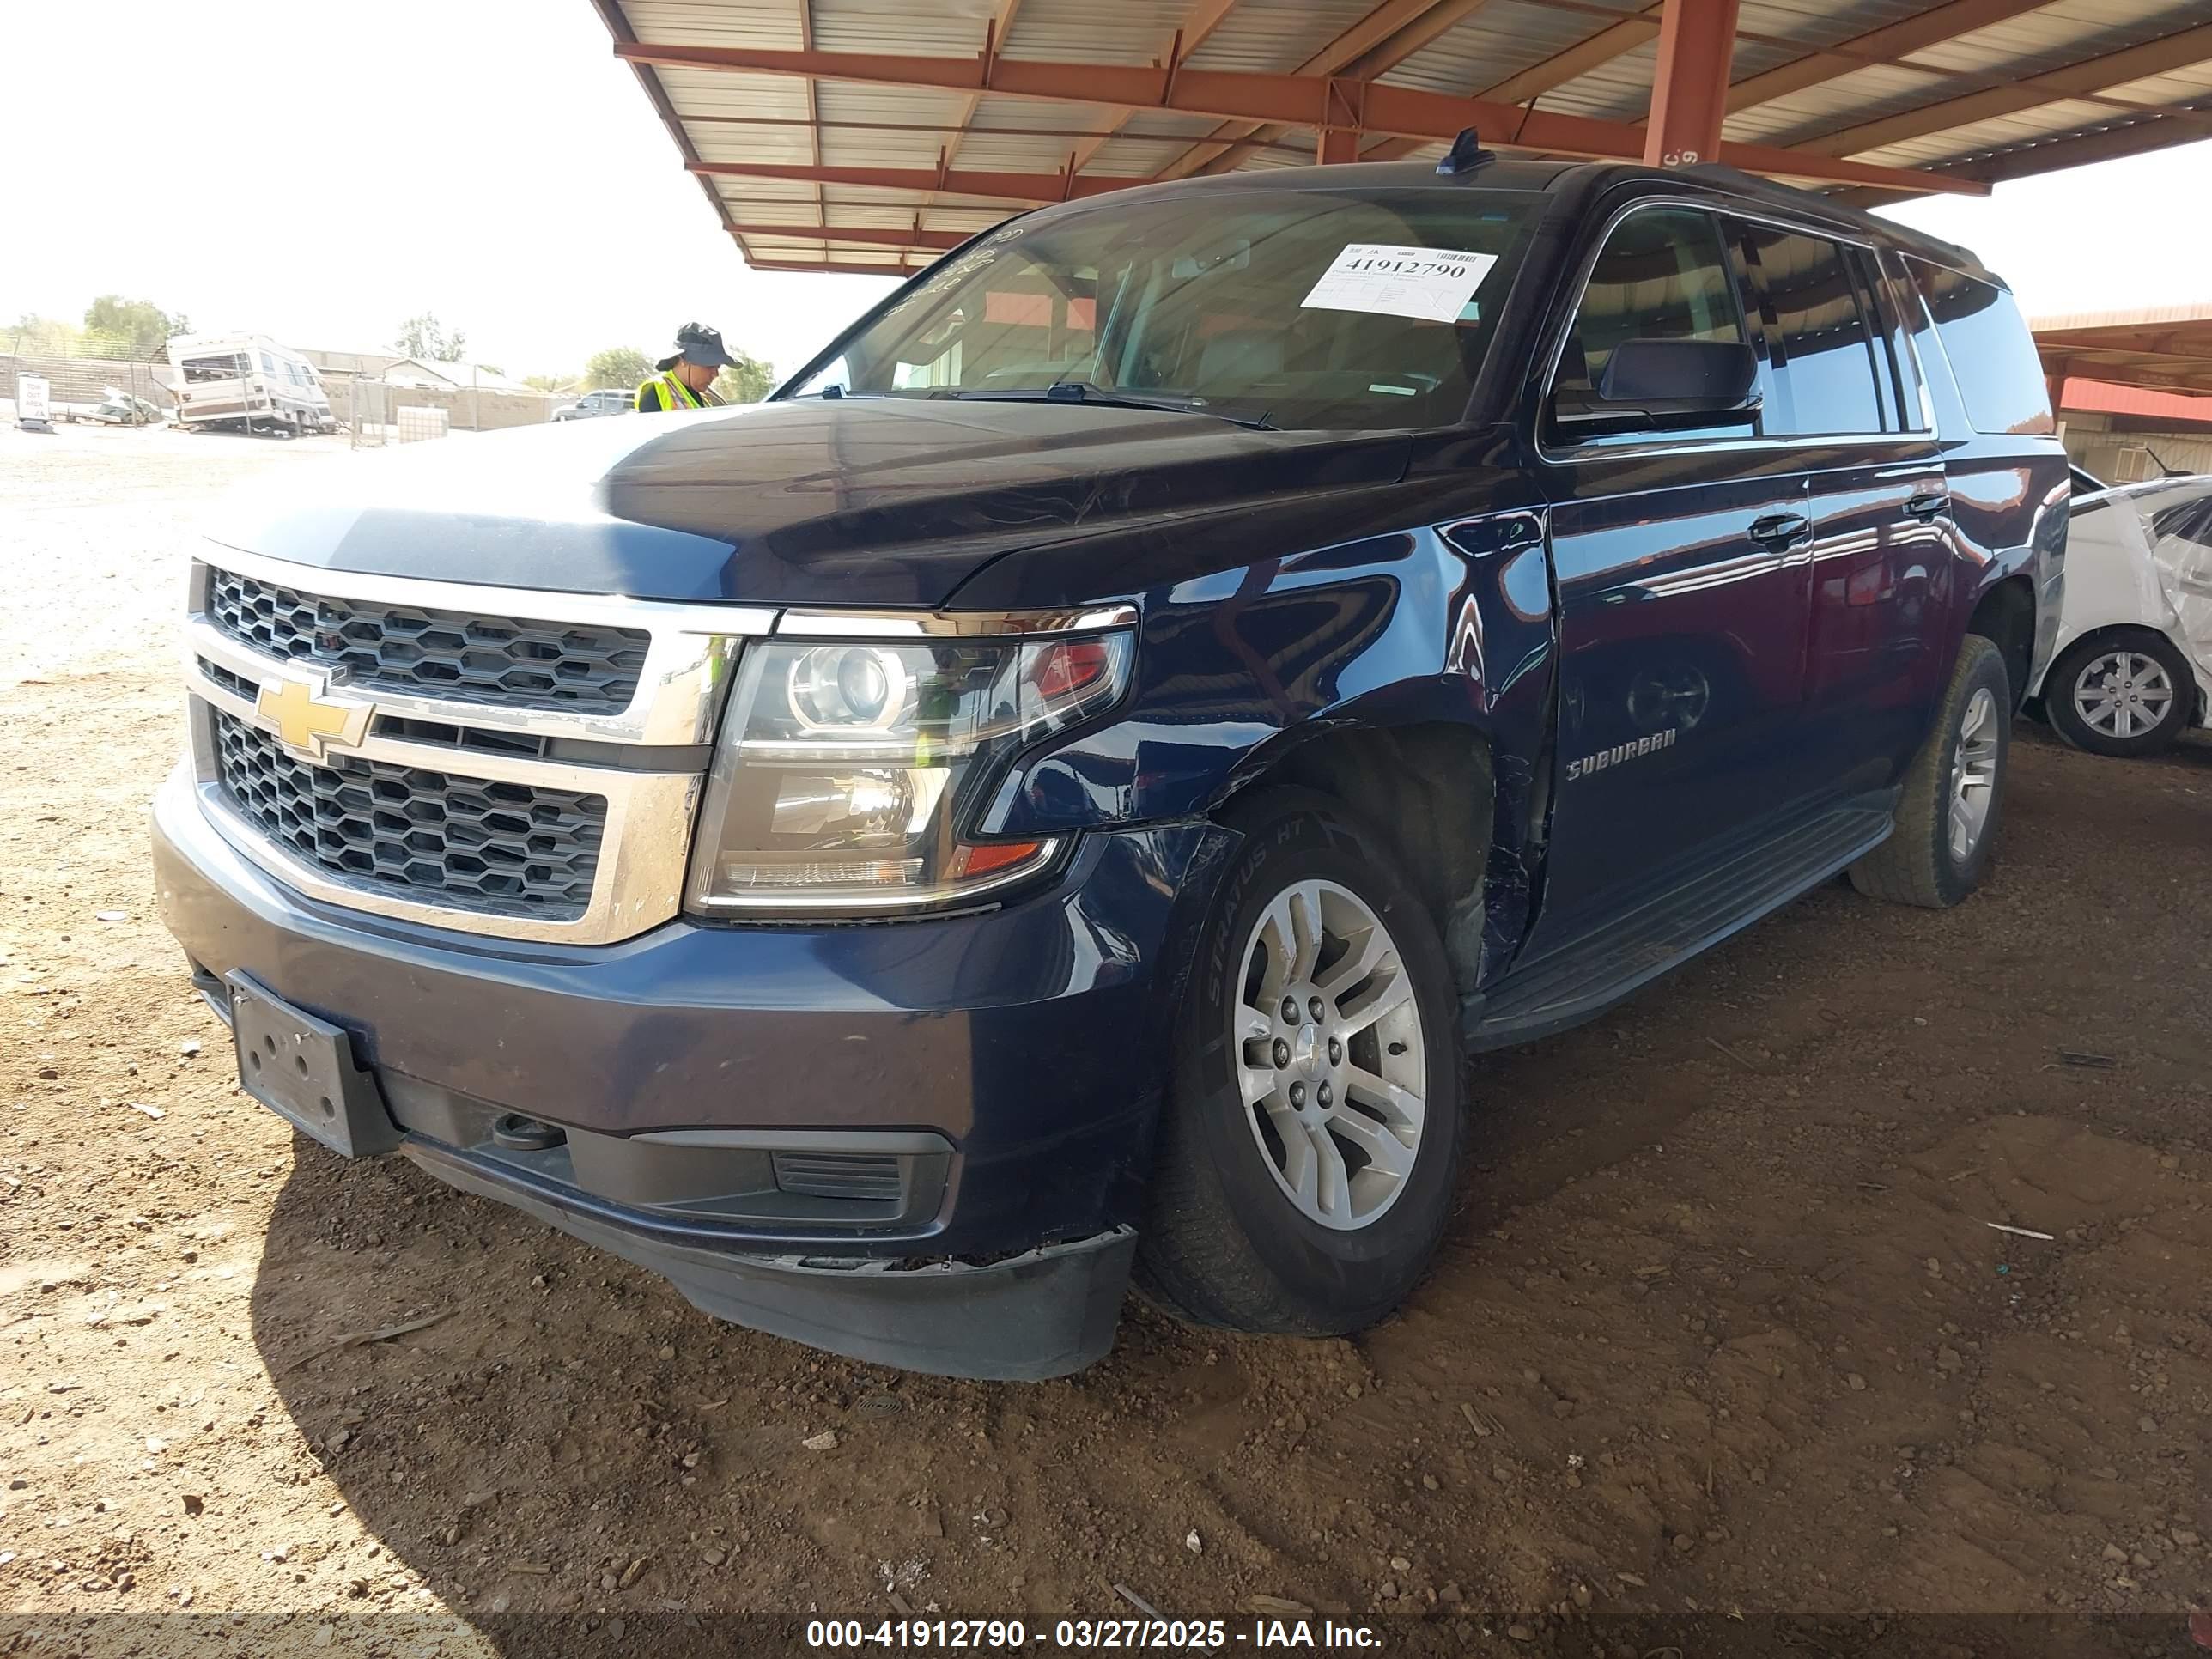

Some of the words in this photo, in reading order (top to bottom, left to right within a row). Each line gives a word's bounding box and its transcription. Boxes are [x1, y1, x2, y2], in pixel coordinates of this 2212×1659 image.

[1346, 258, 1467, 279] 41912790
[1565, 727, 1677, 781] SUBURBAN
[1208, 842, 1267, 1008] STRATUS
[1276, 817, 1305, 845] HT
